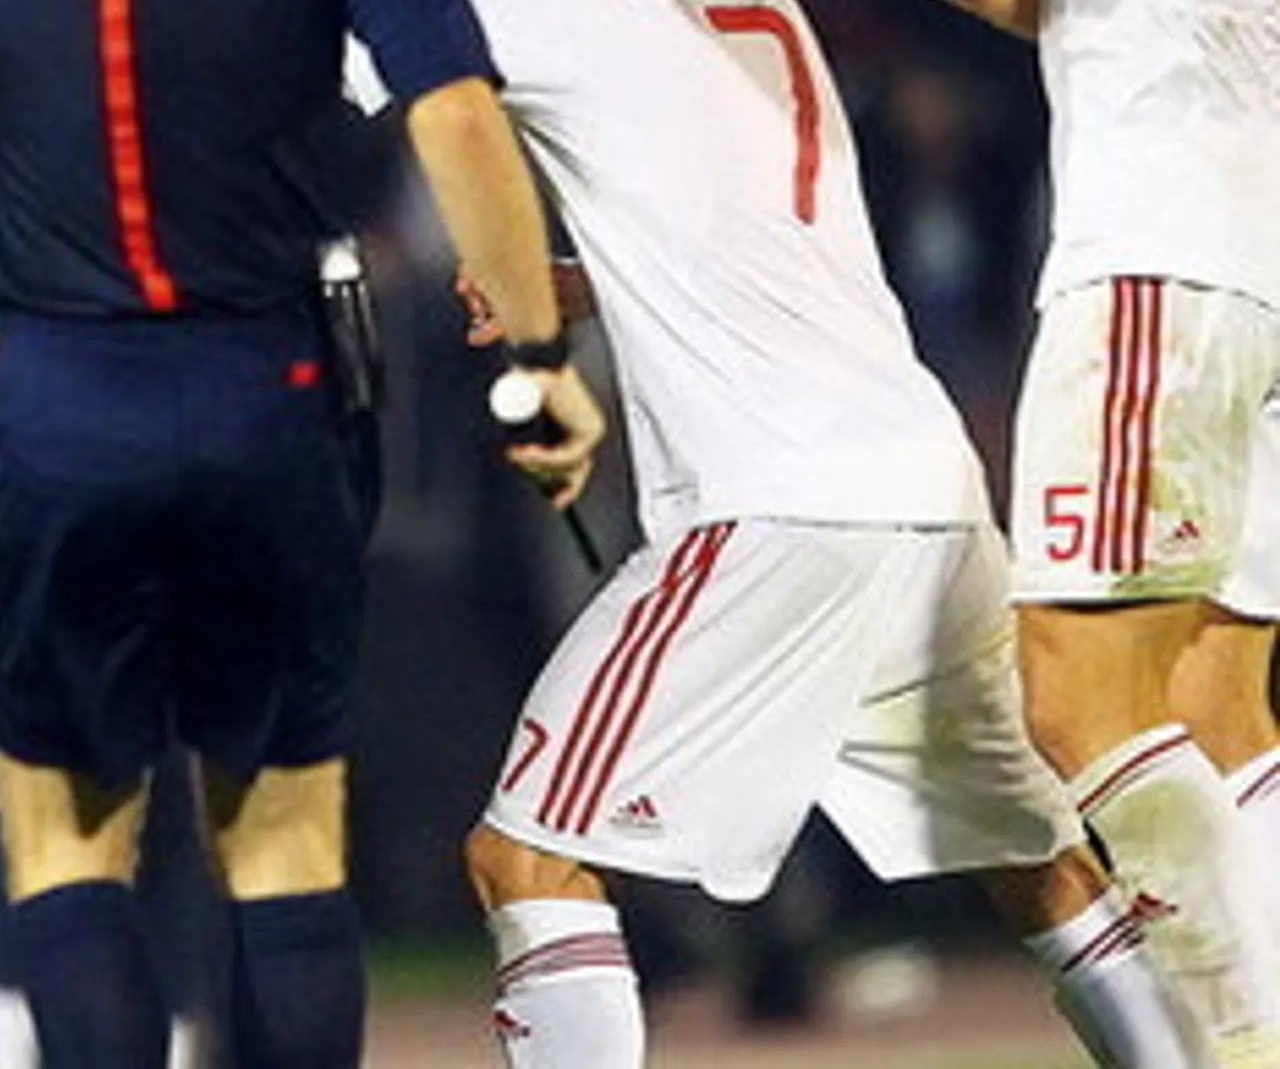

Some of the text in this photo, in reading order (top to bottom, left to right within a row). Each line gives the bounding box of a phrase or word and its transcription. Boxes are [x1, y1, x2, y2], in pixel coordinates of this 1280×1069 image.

[703, 4, 820, 226] 7
[1044, 484, 1089, 563] 5
[500, 717, 550, 793] 7
